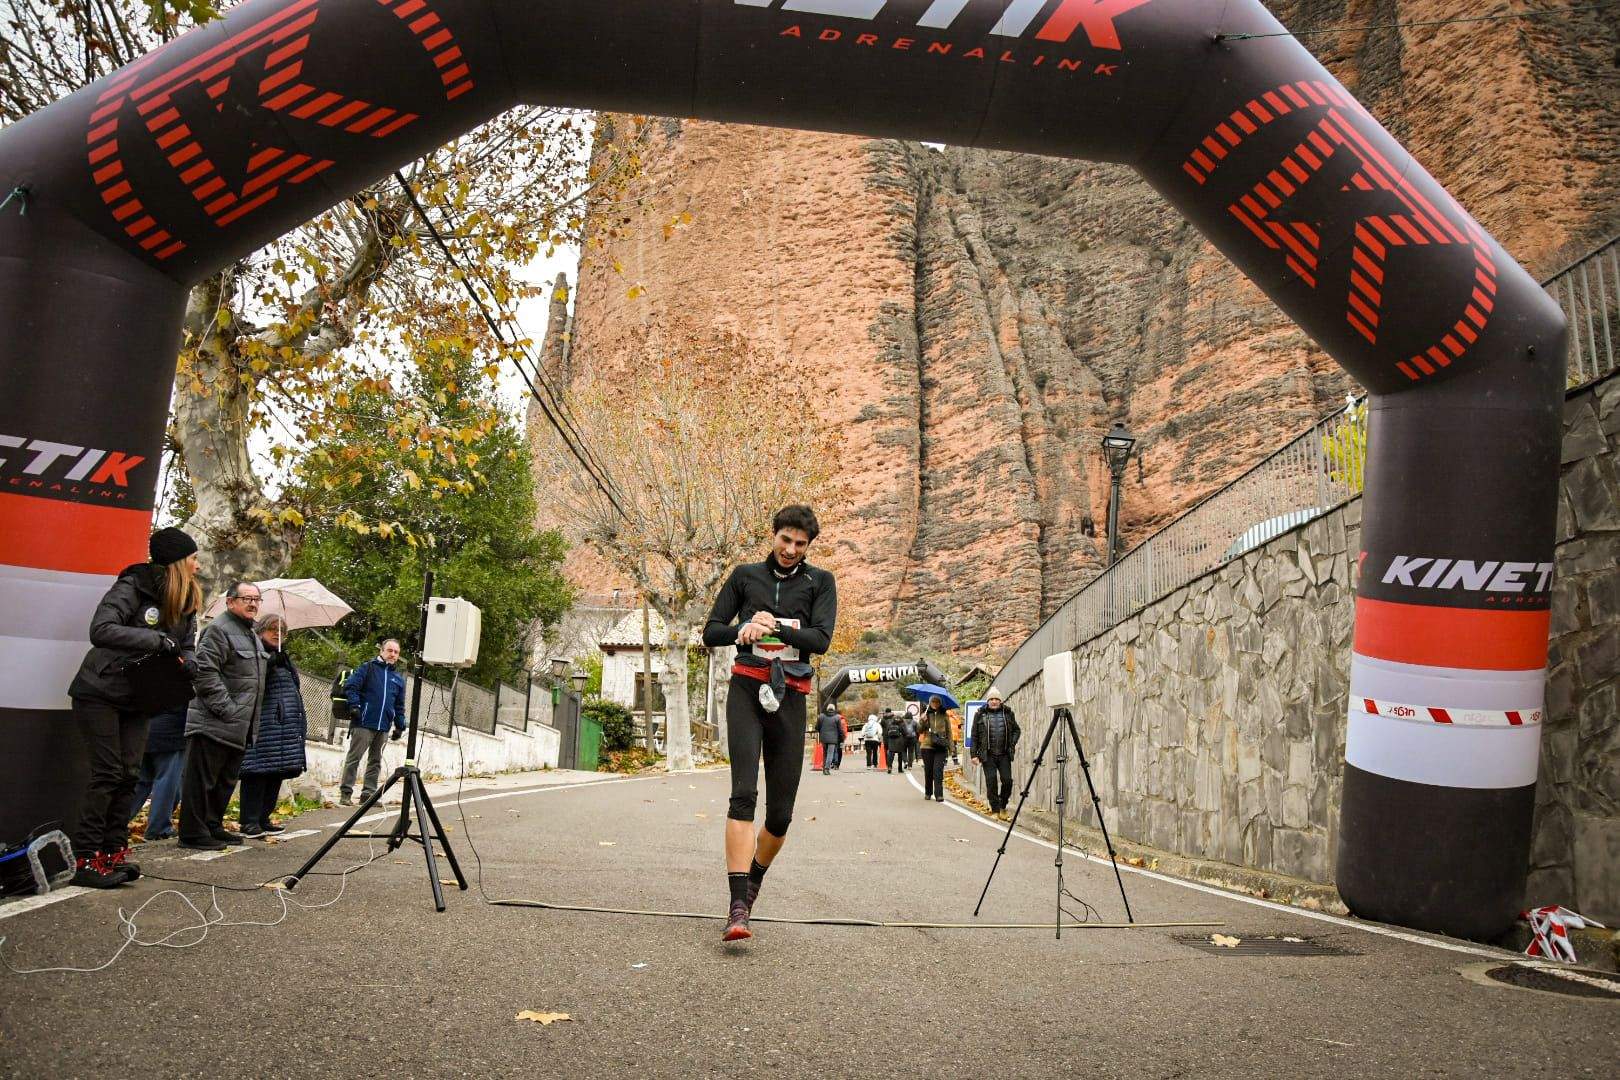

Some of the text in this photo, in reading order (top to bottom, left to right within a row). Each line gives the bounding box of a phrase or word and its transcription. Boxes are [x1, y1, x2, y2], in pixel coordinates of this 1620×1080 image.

[779, 25, 1121, 76] ADRENALINK
[0, 476, 128, 500] ENALINK
[1381, 555, 1553, 592] KINET
